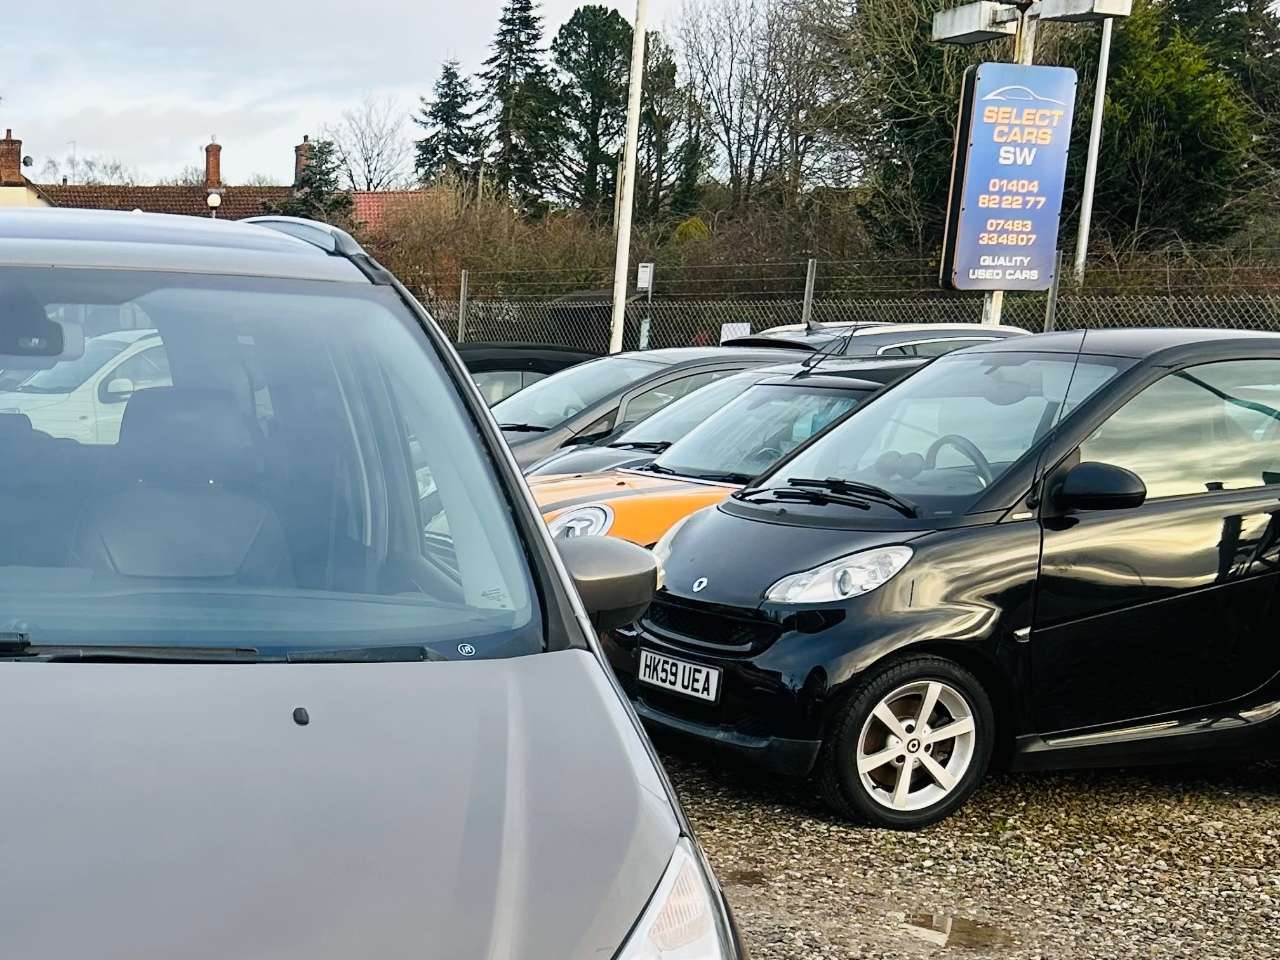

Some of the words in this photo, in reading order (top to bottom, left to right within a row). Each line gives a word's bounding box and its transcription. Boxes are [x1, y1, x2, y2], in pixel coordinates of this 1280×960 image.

[983, 106, 1064, 127] SELECT
[993, 125, 1053, 145] CARS
[999, 146, 1037, 165] SW
[989, 178, 1039, 193] 01404
[979, 233, 1037, 246] 334807
[980, 255, 1031, 267] QUALITY
[968, 268, 1003, 279] USED
[1005, 269, 1039, 280] CARS
[643, 653, 679, 687] HK59
[681, 664, 711, 697] UEA
